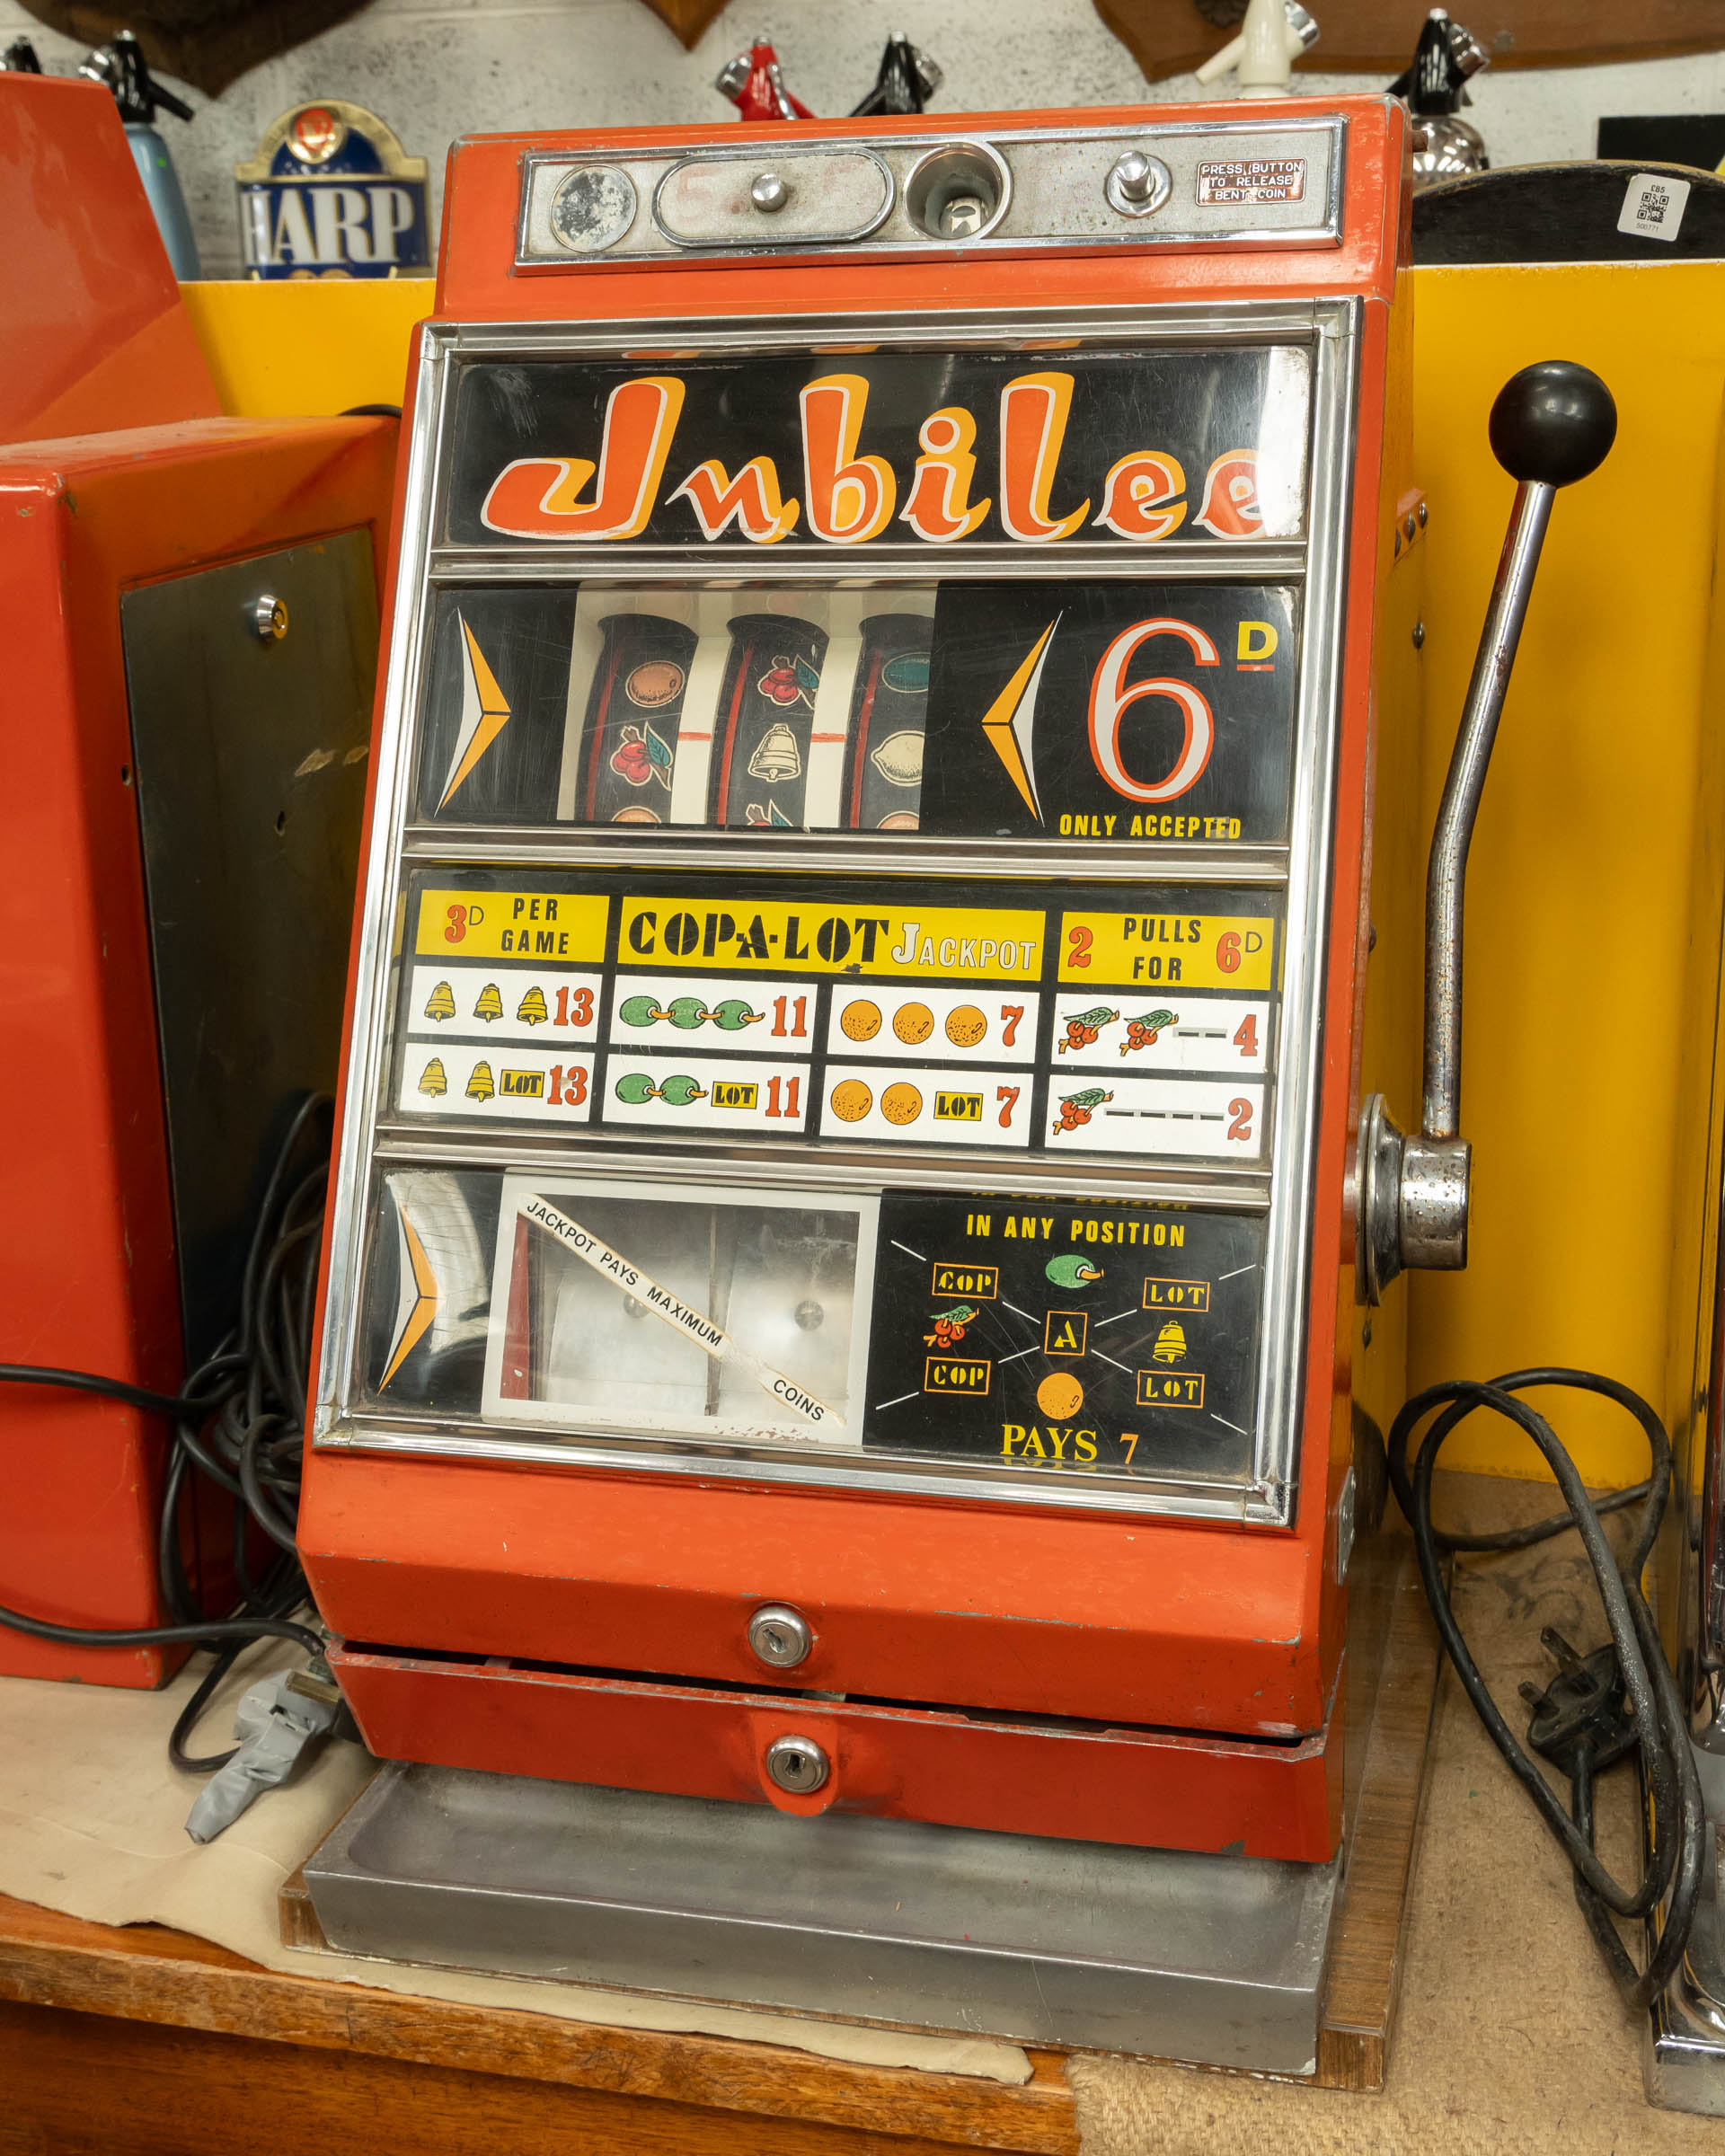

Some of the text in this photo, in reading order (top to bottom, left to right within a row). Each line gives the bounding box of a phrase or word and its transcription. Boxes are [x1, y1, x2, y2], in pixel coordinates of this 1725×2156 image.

[1202, 162, 1302, 174] PRESS BUTTON
[1210, 175, 1293, 187] TO RELEASE
[1215, 189, 1287, 200] BENT COIN
[1650, 184, 1666, 194] £85
[240, 187, 415, 266] HARP
[482, 372, 1268, 544] Jubilee
[1059, 814, 1242, 839] ONLY ACCEPTED
[513, 897, 559, 921] PER
[501, 930, 570, 955] GAME
[891, 922, 1037, 970] JACKPOT
[1123, 917, 1202, 943] PULLS
[1067, 925, 1093, 968] 2
[1133, 957, 1182, 981] FOR
[553, 986, 595, 1027] 13
[771, 995, 808, 1038] 11
[1001, 1005, 1024, 1047] 7
[1233, 1014, 1258, 1057] 4
[503, 1065, 588, 1106] LOT 13
[715, 1076, 801, 1118] LOT 11
[937, 1086, 1021, 1128] LOT 7
[1227, 1097, 1253, 1141] 2
[967, 1215, 1186, 1247] IN ANY POSITION
[940, 1270, 992, 1292] COP
[1150, 1284, 1206, 1305] LOT
[526, 1201, 825, 1422] JACKPOT PAYS MAXIMUM COINS
[1054, 1320, 1078, 1349] A
[933, 1365, 985, 1386] COP
[1146, 1379, 1199, 1401] LOT
[1000, 1424, 1139, 1465] PAYS 7
